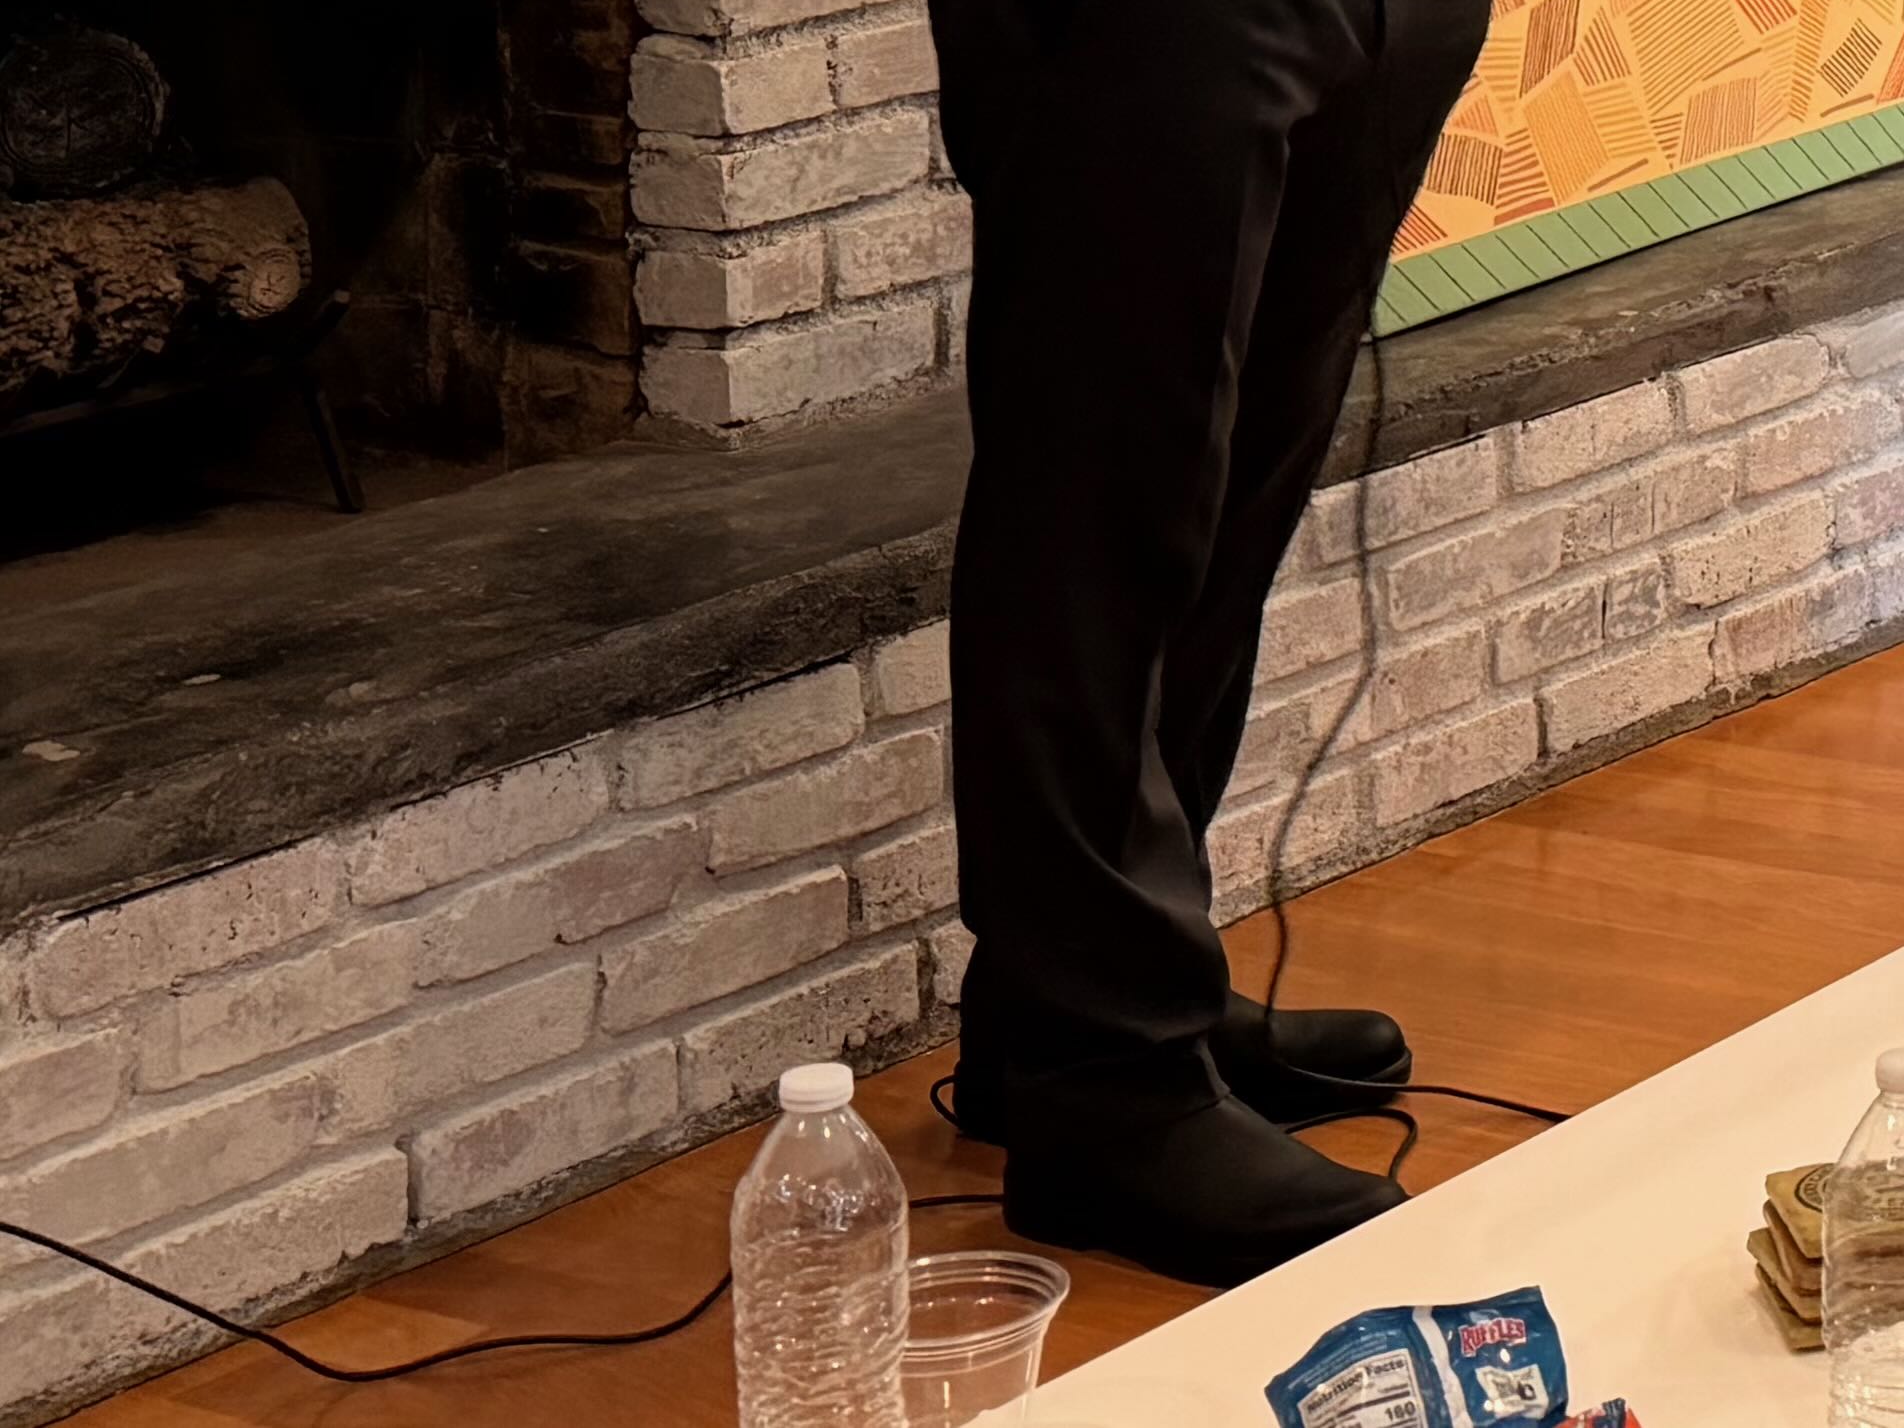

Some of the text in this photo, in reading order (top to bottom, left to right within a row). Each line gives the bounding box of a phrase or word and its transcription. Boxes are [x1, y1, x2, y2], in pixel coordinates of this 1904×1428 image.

[1460, 1319, 1526, 1356] RUFFLES
[1307, 1358, 1405, 1413] Nutrition Facts
